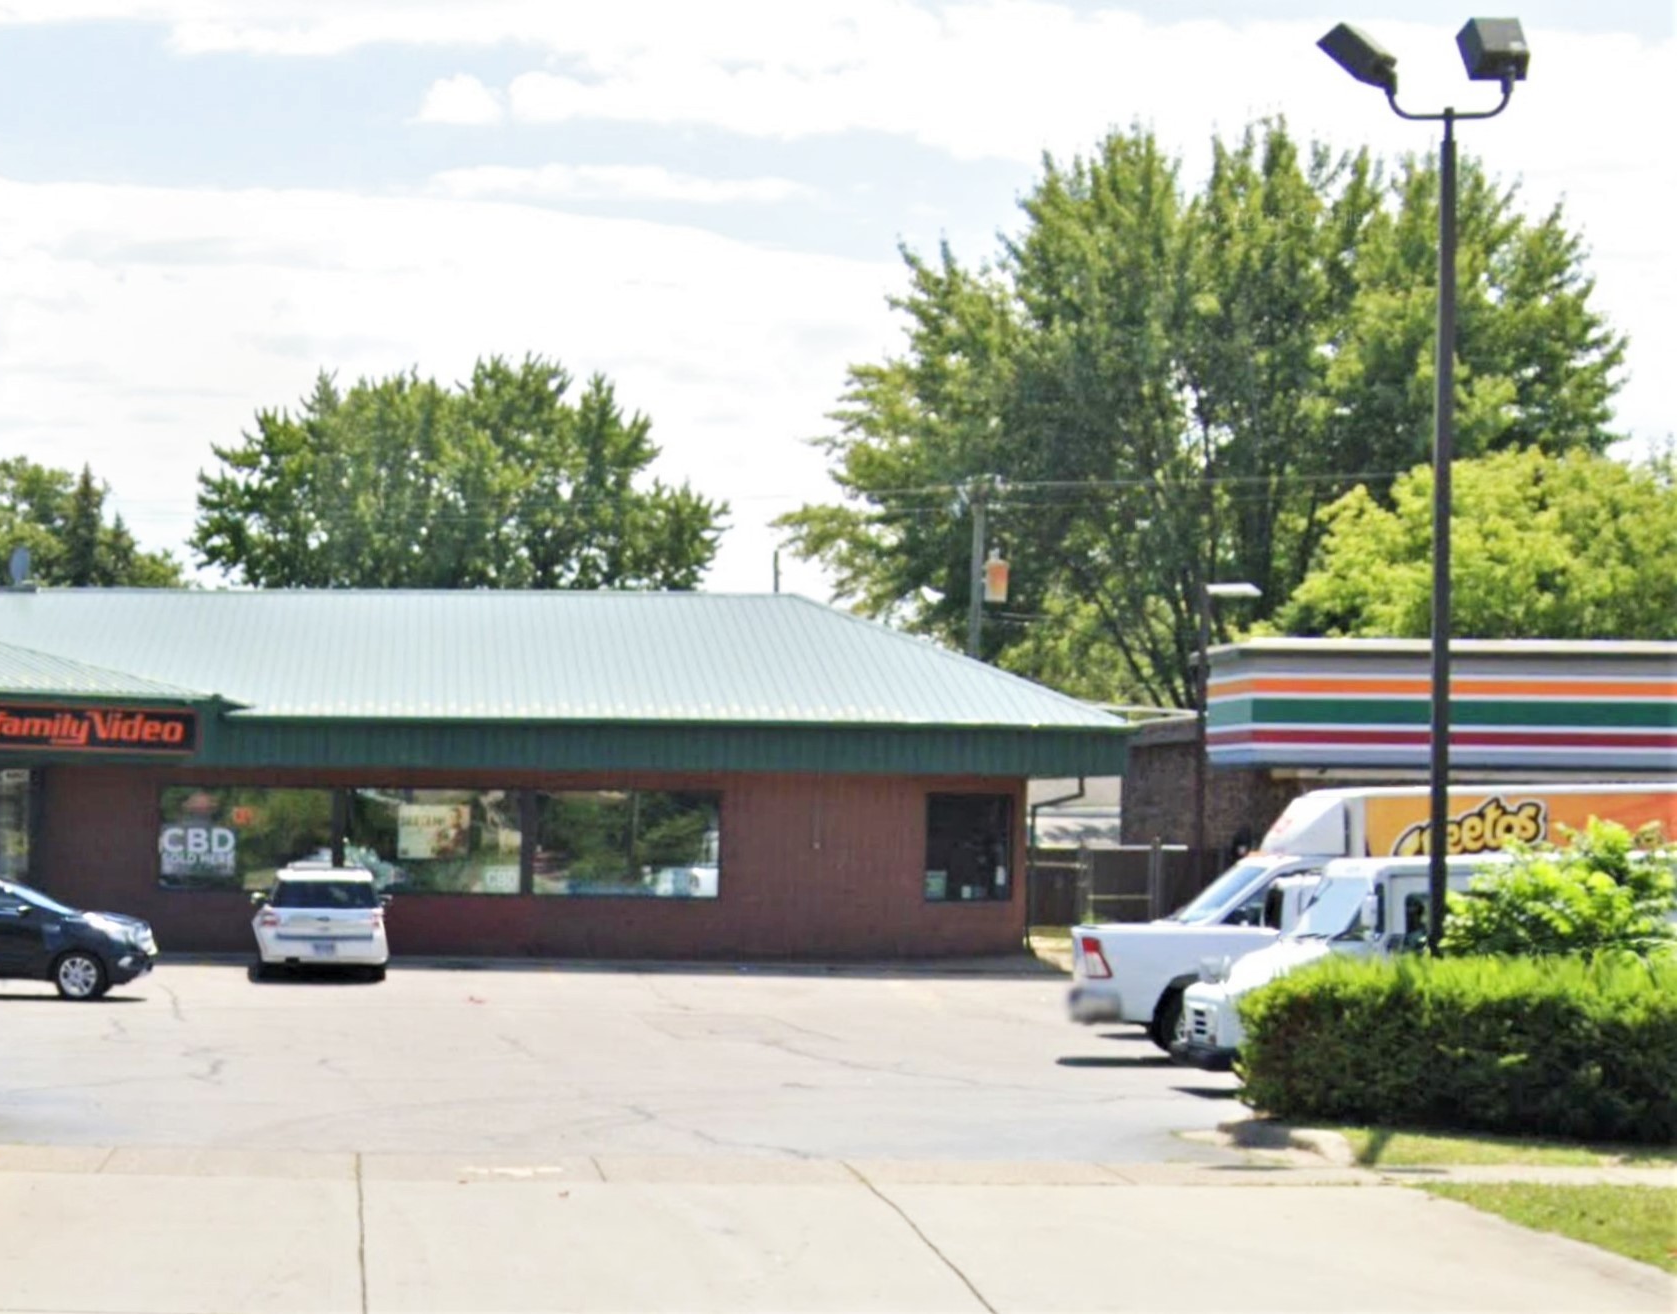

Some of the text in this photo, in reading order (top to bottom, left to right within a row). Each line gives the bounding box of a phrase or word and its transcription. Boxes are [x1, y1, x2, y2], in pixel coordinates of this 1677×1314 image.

[86, 709, 185, 743] Video
[161, 827, 235, 854] CBD
[1393, 797, 1545, 857] eetos
[486, 870, 518, 887] CBD
